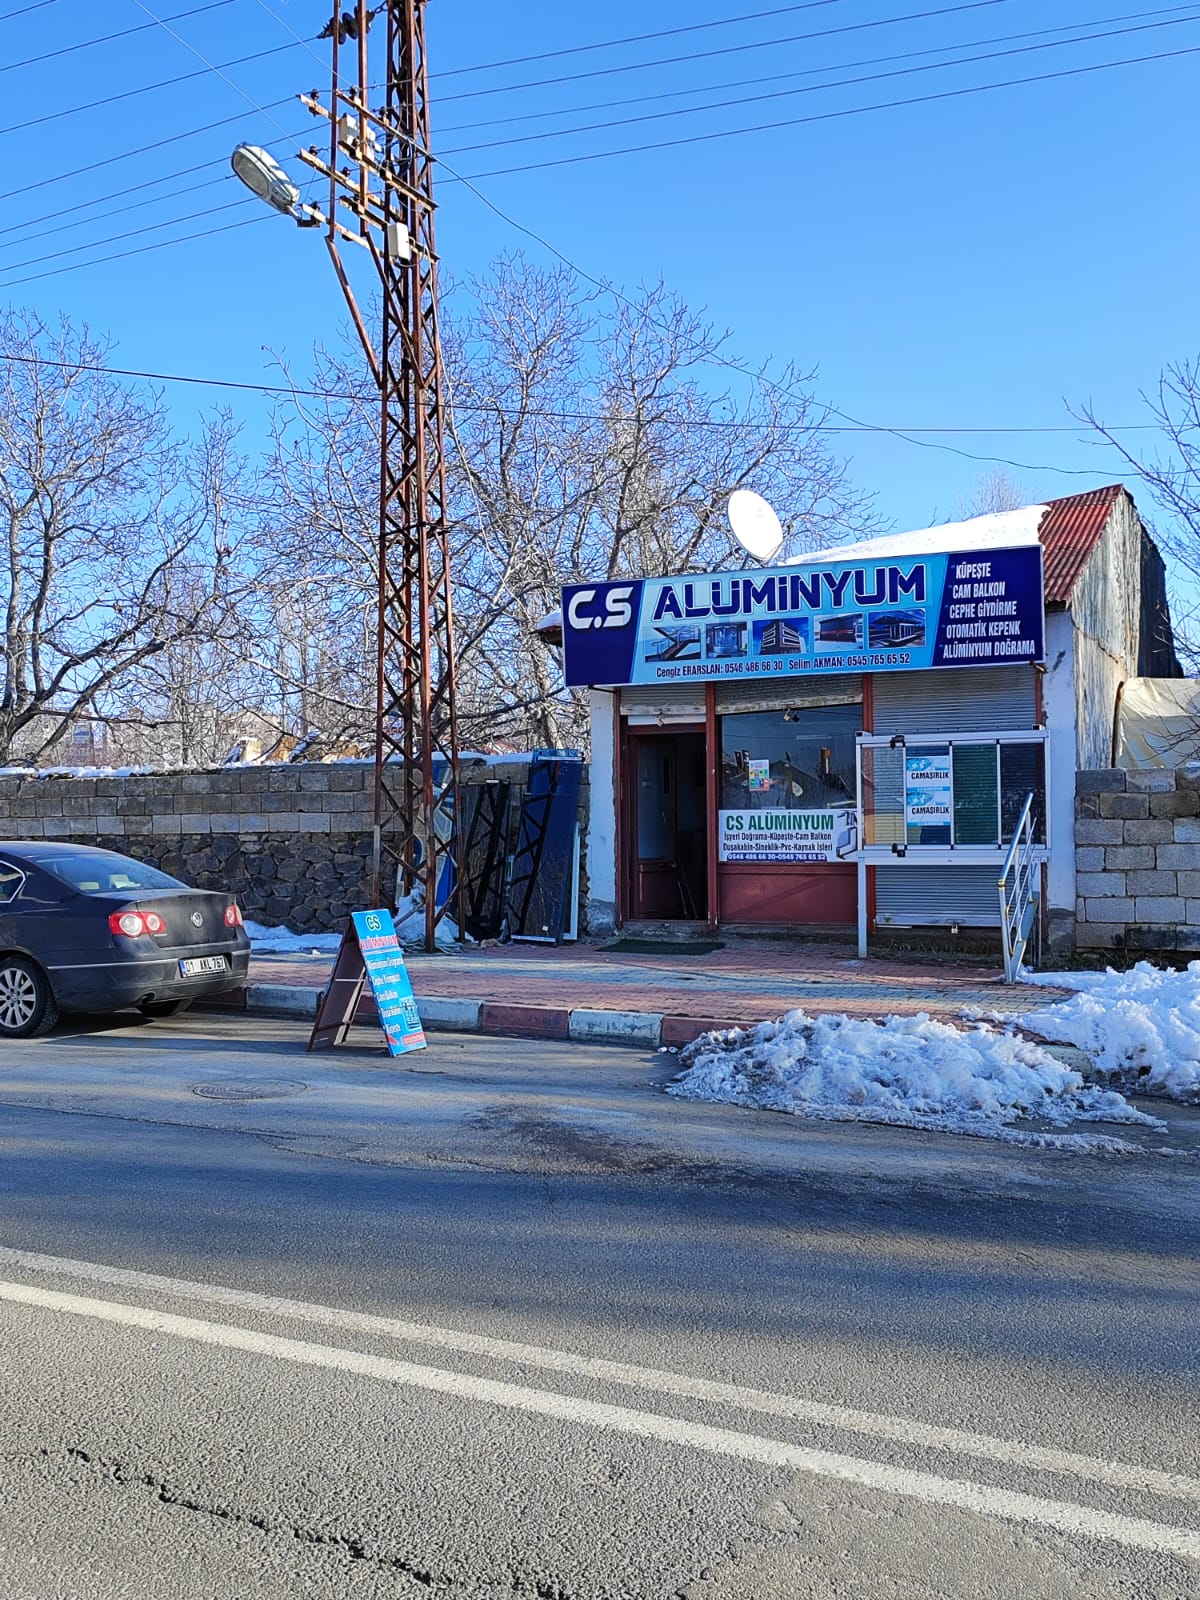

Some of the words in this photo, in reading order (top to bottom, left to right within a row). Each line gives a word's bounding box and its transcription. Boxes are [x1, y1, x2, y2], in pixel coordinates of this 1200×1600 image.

[955, 561, 992, 579] KÜPEŞTE
[652, 564, 926, 621] ALÜMİNYUM
[952, 584, 972, 599] CAM
[973, 581, 1006, 598] BALKON
[568, 586, 634, 630] C.S
[949, 603, 976, 619] CEPHE
[977, 599, 1018, 617] GİYDİRME
[946, 620, 987, 639] OTOMATİK
[988, 621, 1021, 636] KEPENK
[943, 641, 992, 659] ALÜMİNYUM
[994, 638, 1036, 656] DOĞRAMA
[657, 667, 681, 678] Cengiz
[683, 663, 723, 676] ERARSLAN:
[725, 661, 743, 673] 0546
[745, 661, 760, 672] 486
[761, 661, 771, 671] 66
[773, 660, 783, 671] 30
[789, 659, 811, 670] Selim
[814, 656, 845, 668] AKMAN:
[847, 656, 867, 666] 0545
[870, 655, 885, 665] 765
[887, 654, 898, 664] 65
[900, 653, 910, 664] 52
[726, 815, 744, 831] CS
[748, 812, 834, 831] ALÜMİNYUM
[810, 832, 832, 841] Balkon
[185, 961, 195, 972] 01
[200, 958, 212, 970] AKL
